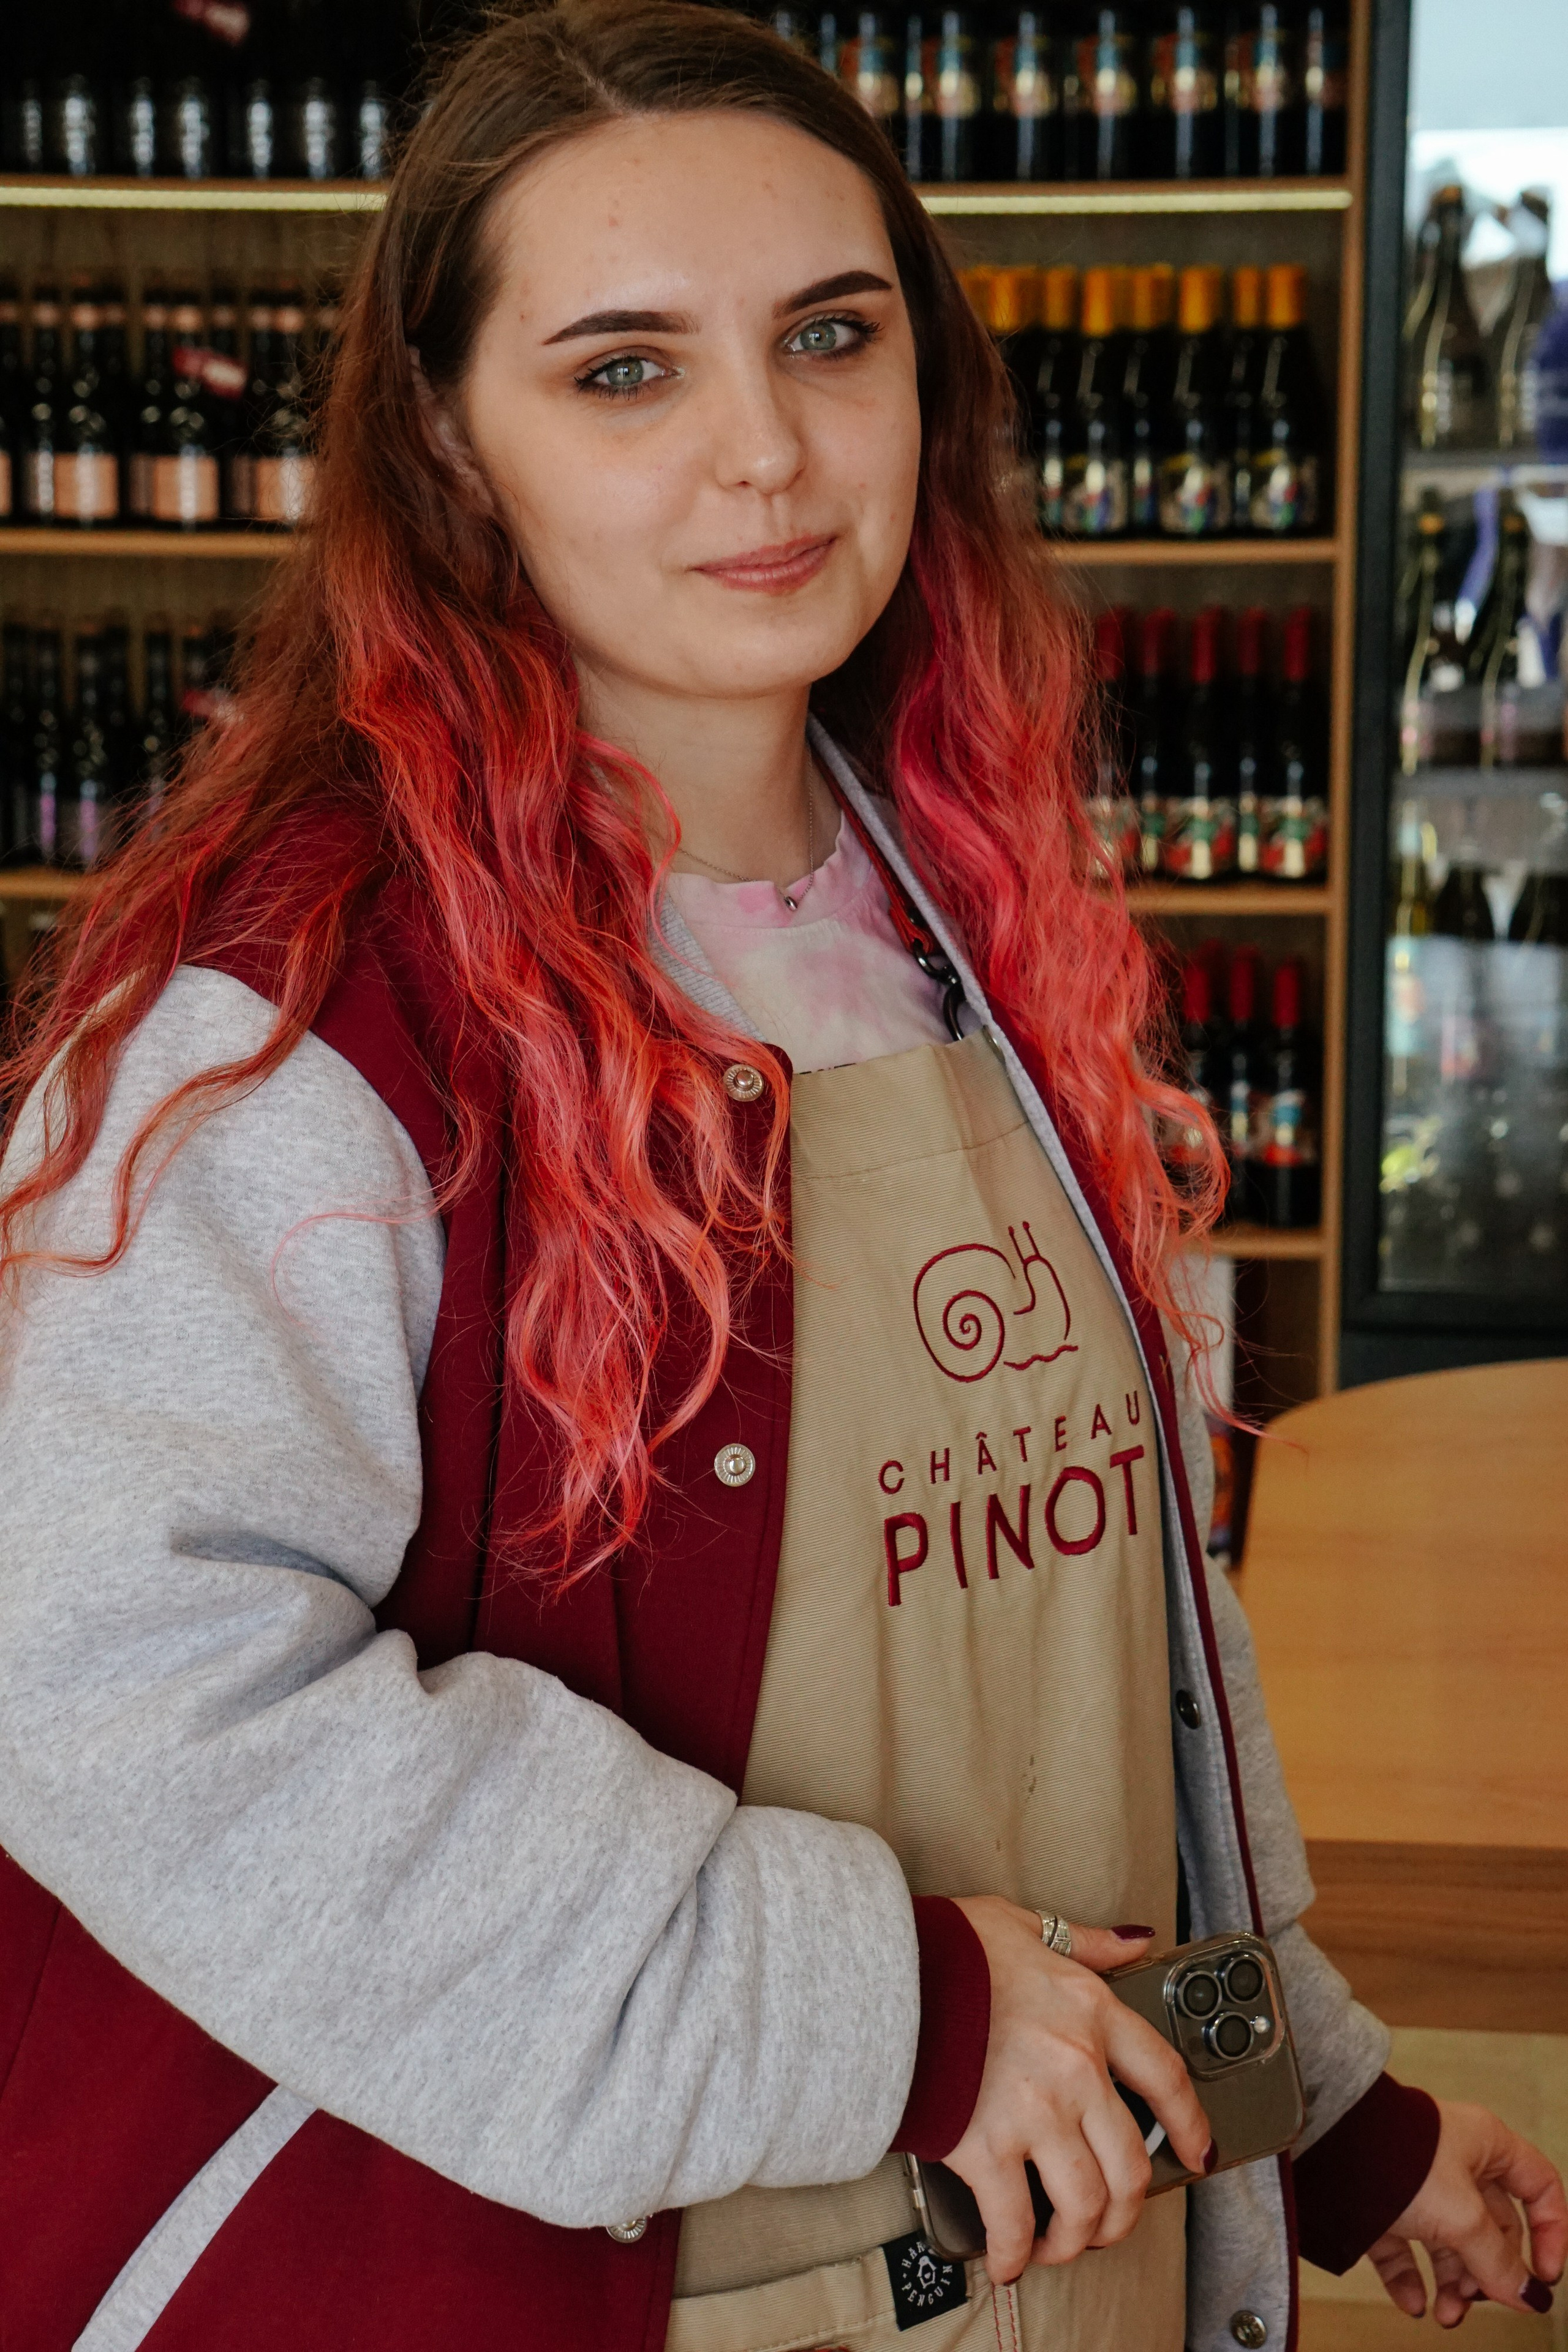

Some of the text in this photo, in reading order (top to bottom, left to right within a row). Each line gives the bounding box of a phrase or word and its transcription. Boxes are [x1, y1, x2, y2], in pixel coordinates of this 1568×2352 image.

[878, 1390, 1140, 1494] CHÂTEAU
[884, 1444, 1145, 1607] PINOT
[901, 2264, 953, 2307] PENGUIN
